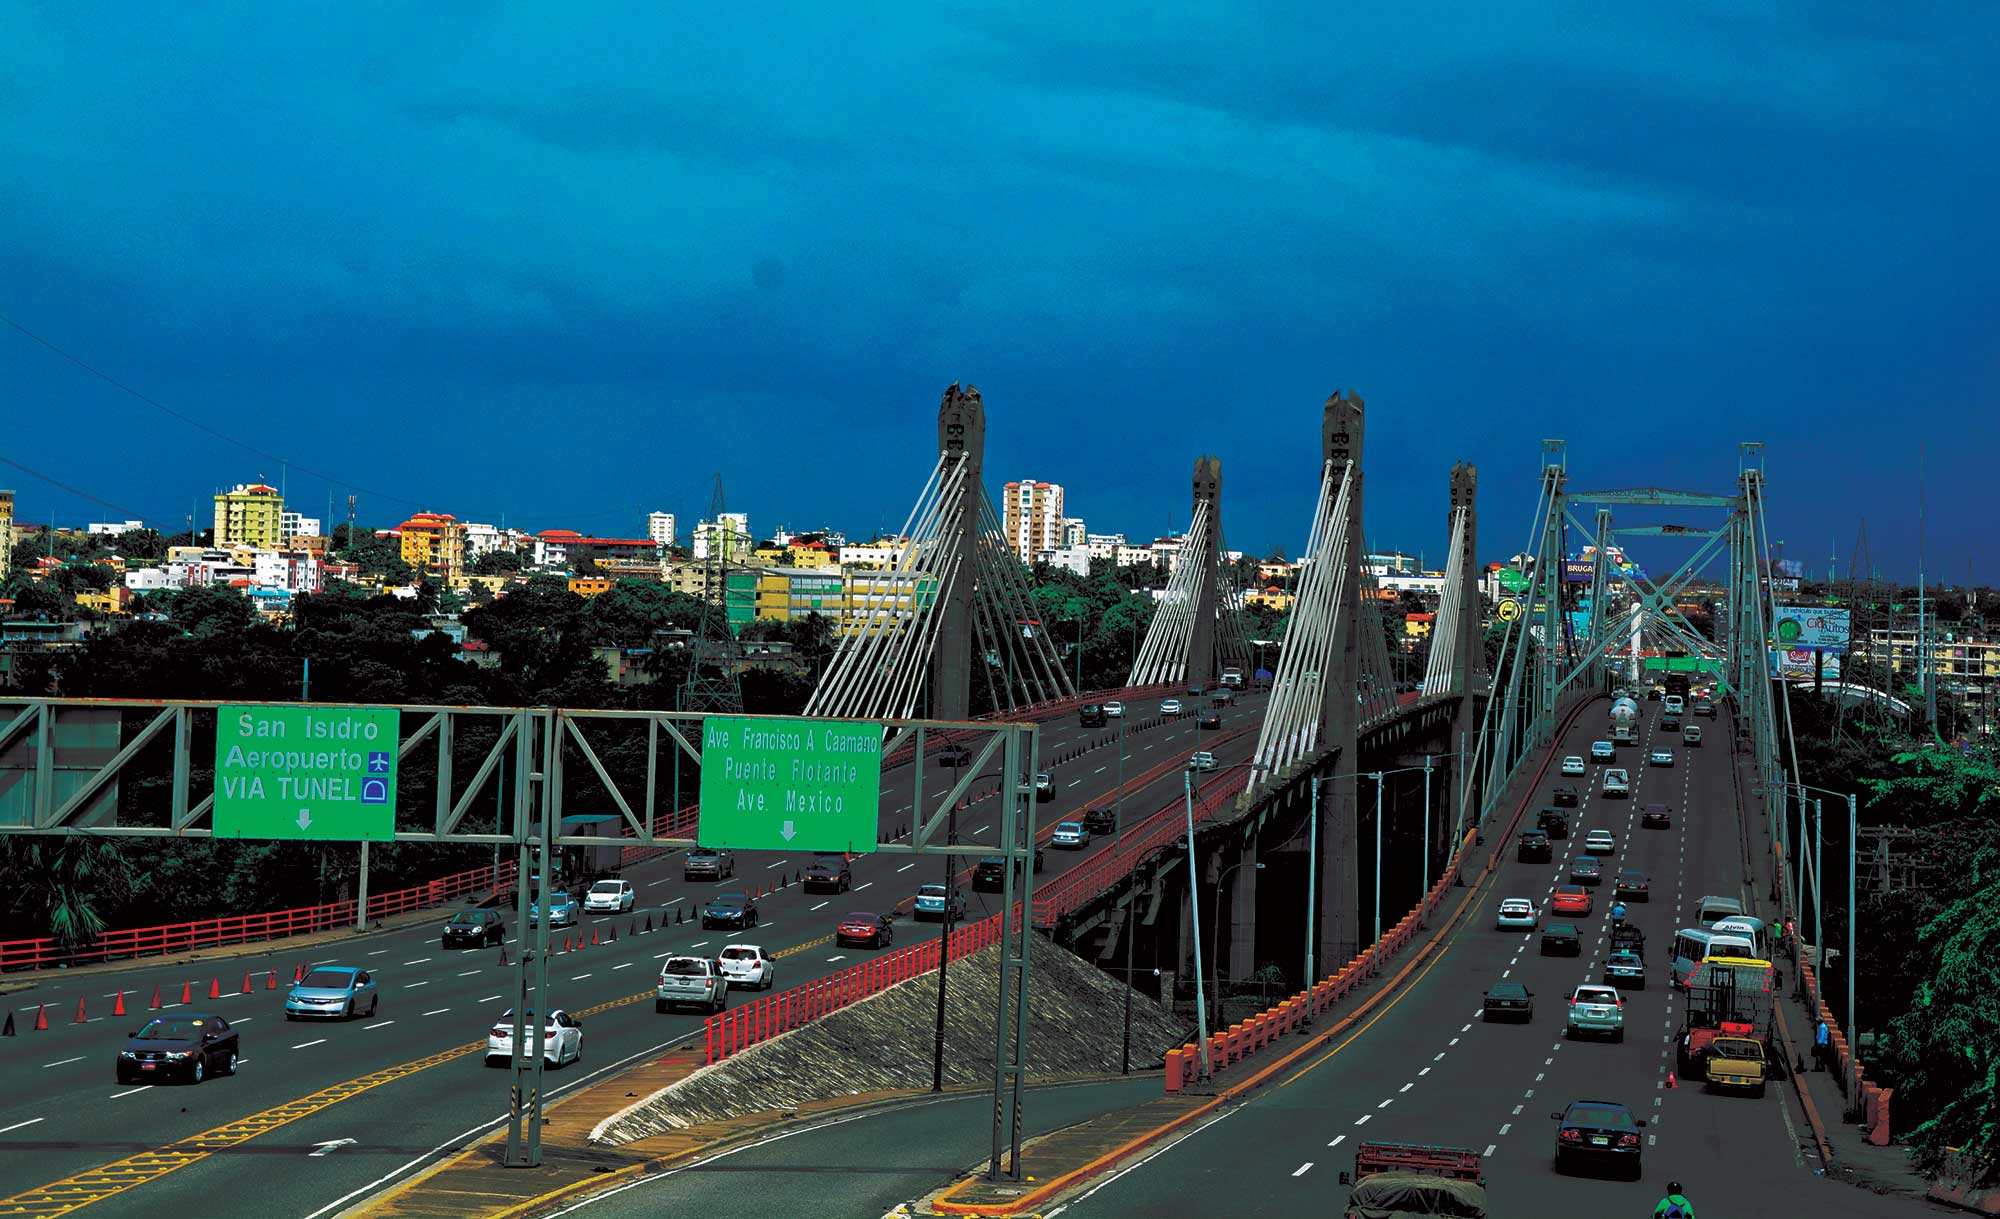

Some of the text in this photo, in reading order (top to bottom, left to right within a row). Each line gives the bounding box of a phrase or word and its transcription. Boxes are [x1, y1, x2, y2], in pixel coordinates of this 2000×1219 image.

[1567, 564, 1595, 572] BRUGA
[239, 714, 378, 740] San Isidro
[707, 726, 878, 753] Ave Francisco A Caamano
[224, 745, 362, 773] Aeropuerto
[725, 757, 857, 783] Puente Flotante
[223, 776, 356, 800] VIA TUNEL
[737, 788, 843, 813] Ave. Mexico
